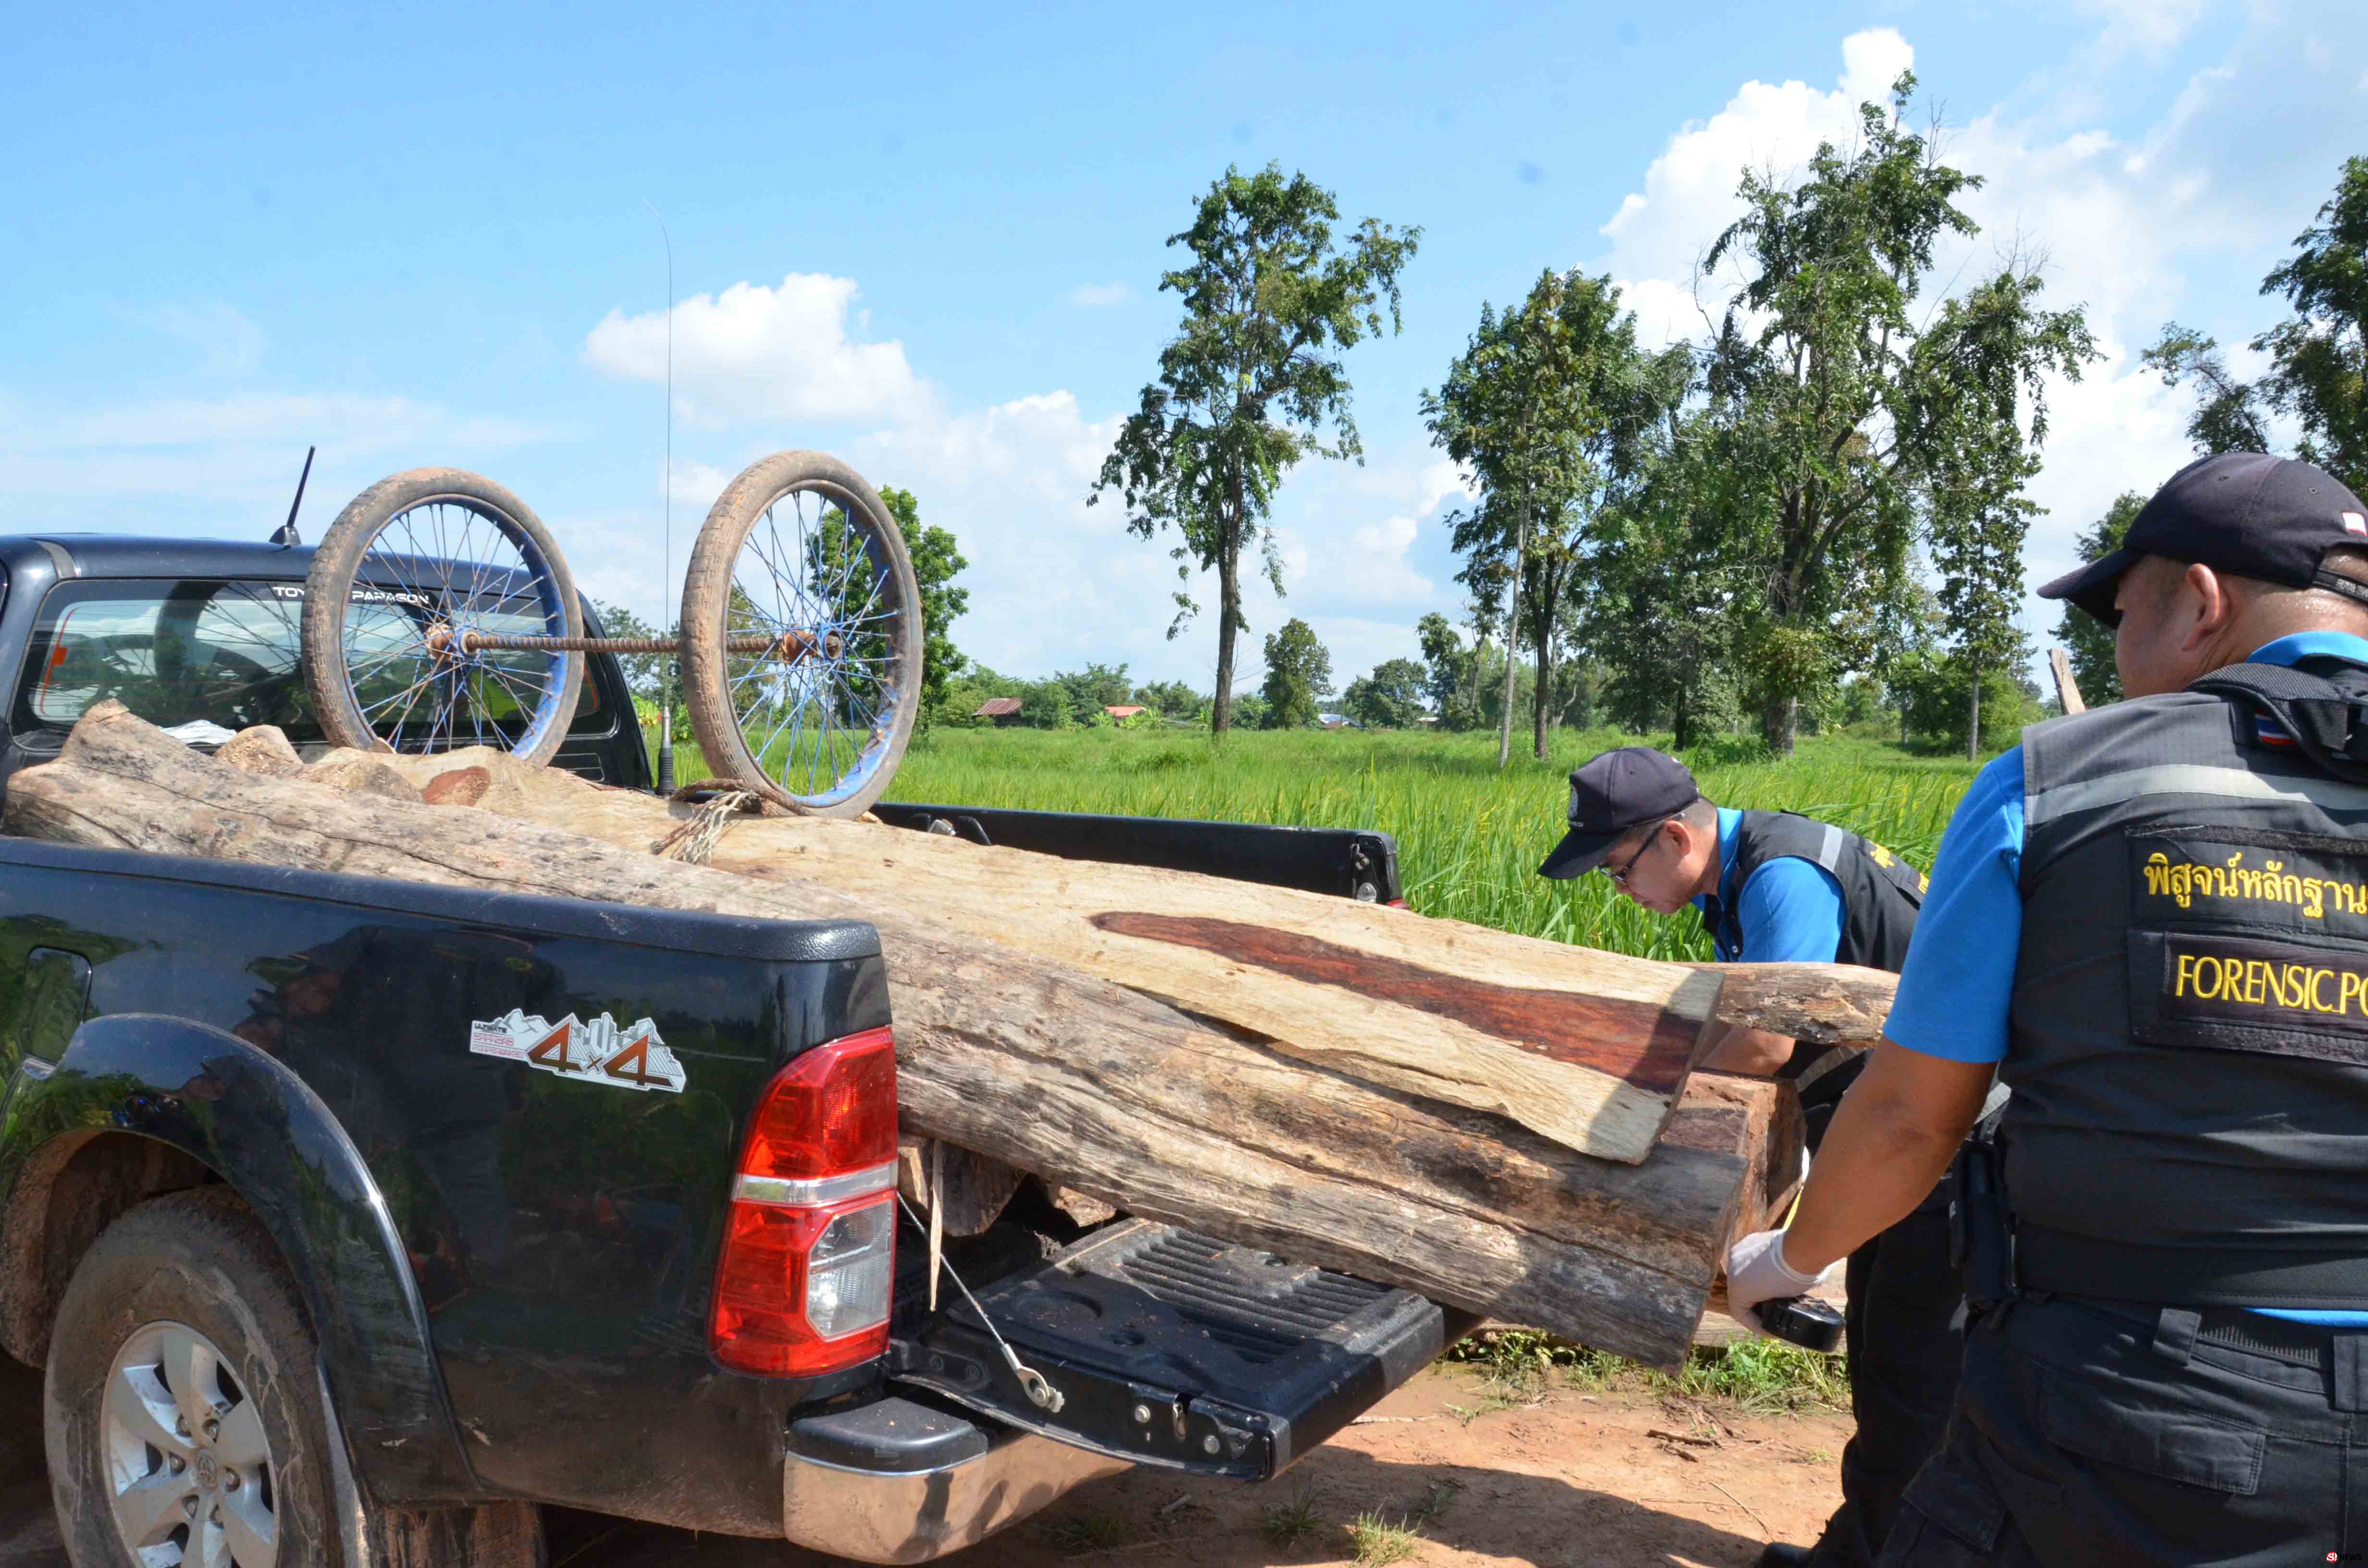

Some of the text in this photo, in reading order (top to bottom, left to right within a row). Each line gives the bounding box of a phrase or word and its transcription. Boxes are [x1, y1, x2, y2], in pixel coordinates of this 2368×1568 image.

[352, 590, 429, 604] PARAGON
[2144, 852, 2367, 919] พิสูจน์หลักฐาน
[2175, 955, 2334, 1013] FORENSIC
